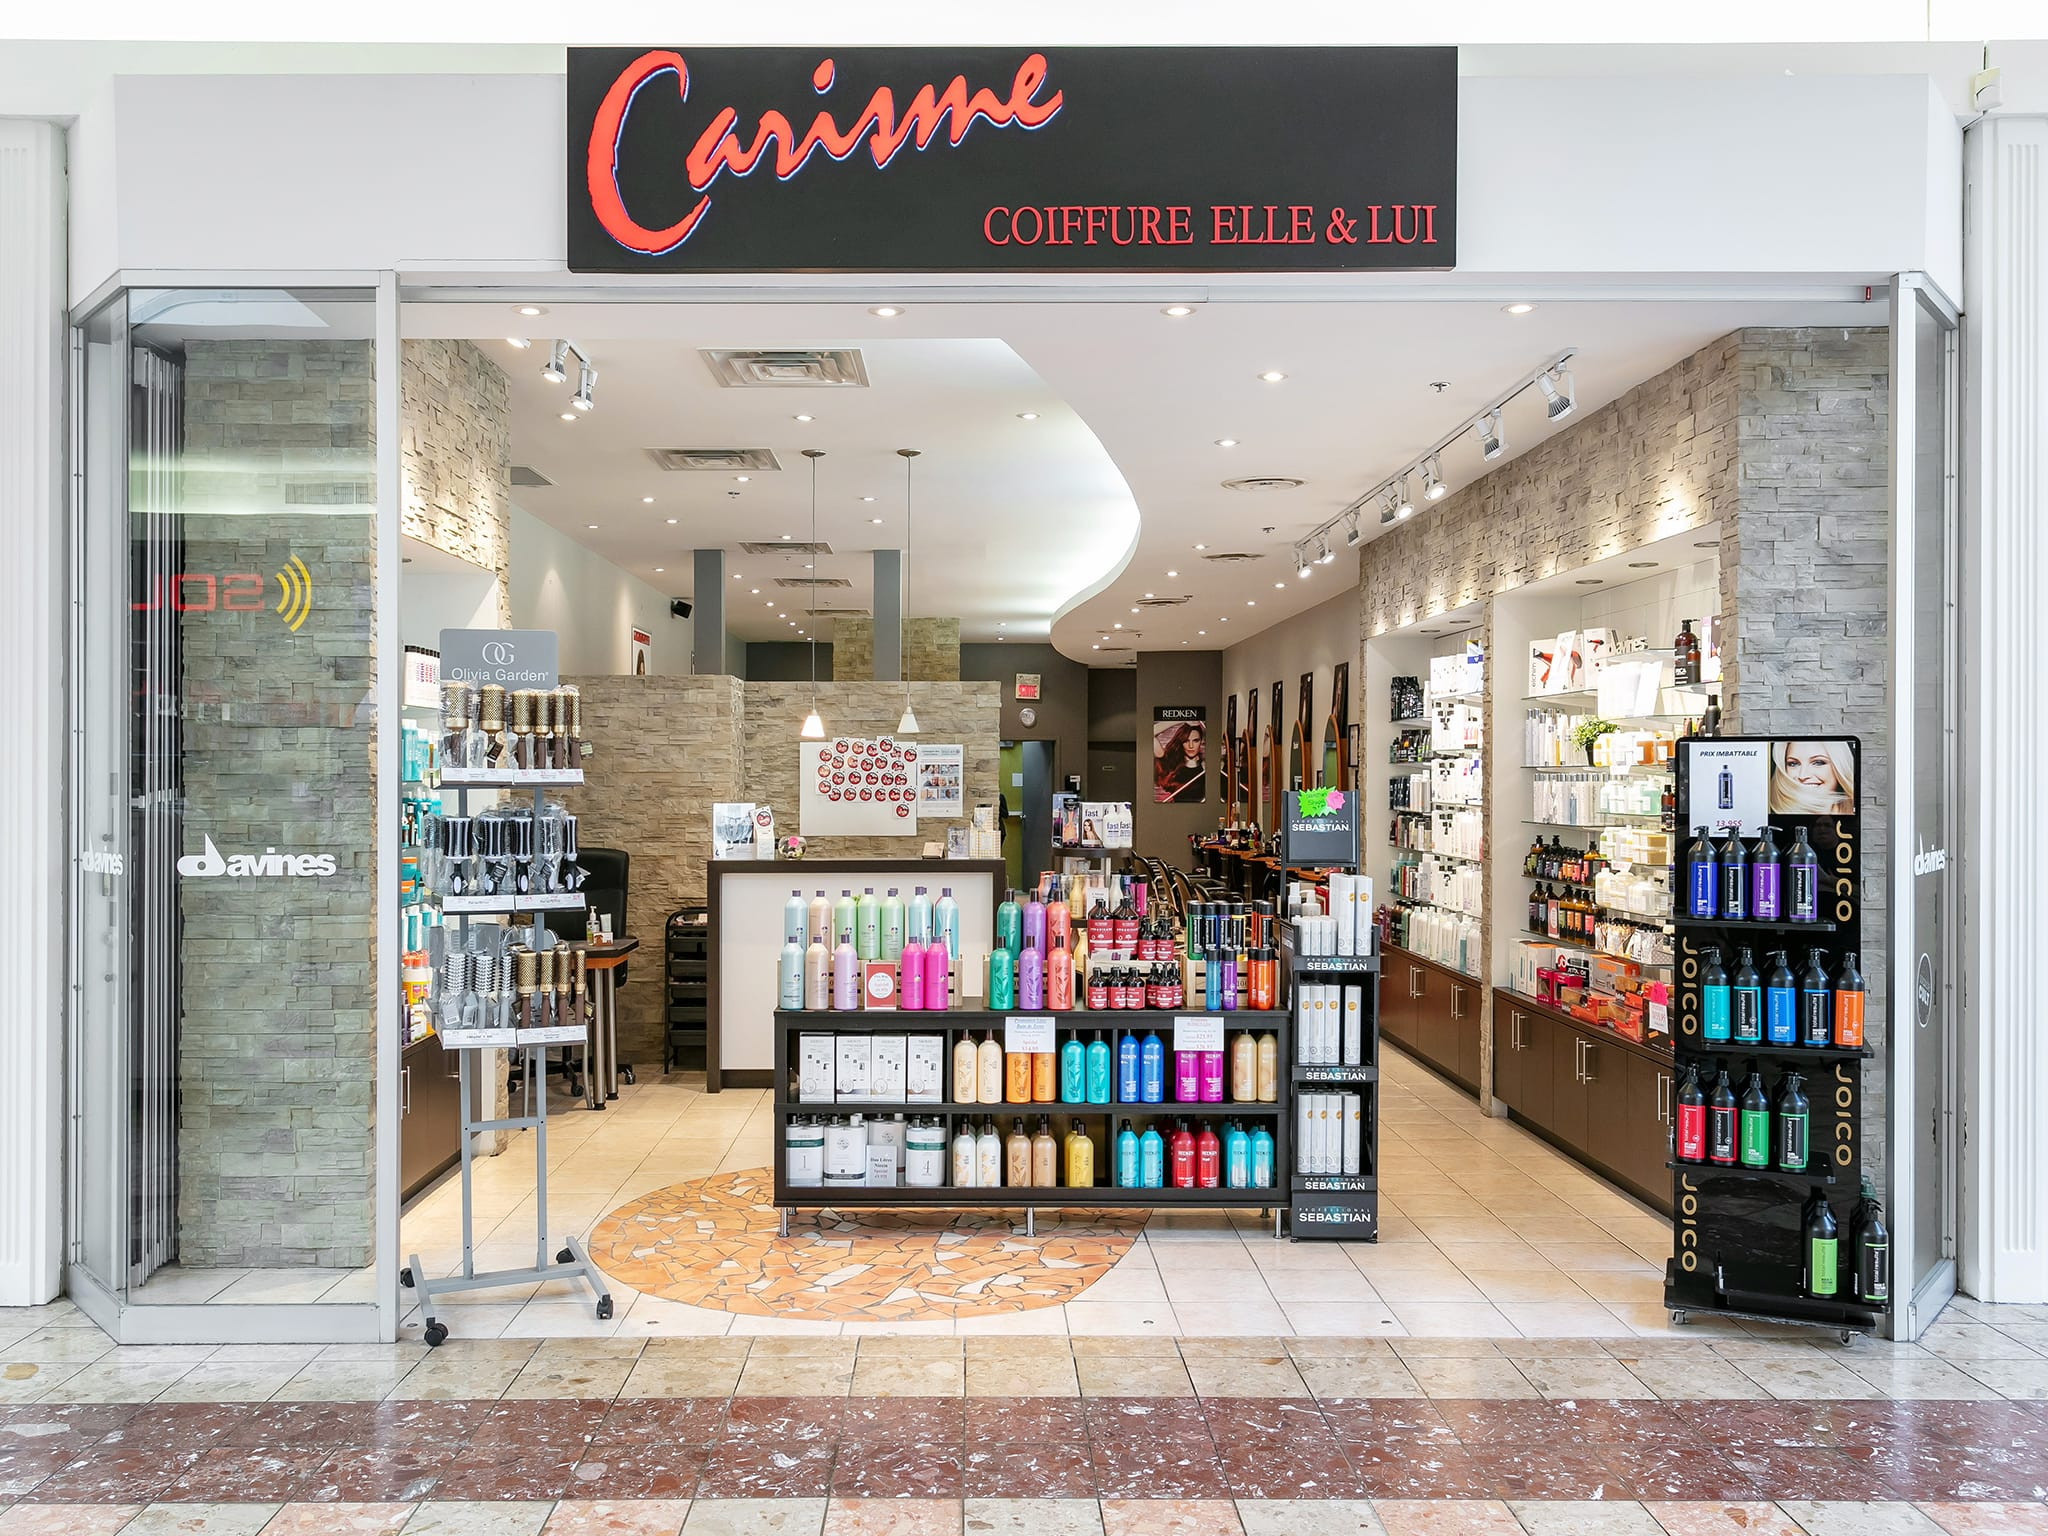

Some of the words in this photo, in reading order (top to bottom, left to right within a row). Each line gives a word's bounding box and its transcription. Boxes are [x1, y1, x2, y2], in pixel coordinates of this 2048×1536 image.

[587, 50, 1064, 256] Carisme
[983, 205, 1195, 247] COIFFURE
[1210, 205, 1315, 246] ELLE
[1326, 205, 1357, 245] &
[1366, 204, 1438, 245] LUI
[452, 668, 490, 681] Olivia
[1162, 709, 1197, 718] REDKEN
[1085, 809, 1098, 817] fast
[1292, 824, 1349, 832] SEBASTIAN
[177, 833, 337, 877] davines
[1914, 832, 1945, 876] davines
[1836, 820, 1853, 922] JOICO
[1307, 963, 1367, 971] SEBASTIAN
[1682, 936, 1698, 1035] JOICO
[1305, 1072, 1366, 1081] SEBASTIAN
[1836, 1064, 1853, 1167] JOICO
[1305, 1181, 1365, 1190] SEBASTIAN
[1299, 1213, 1370, 1222] SEBASTIAN
[1681, 1173, 1698, 1272] JOICO
